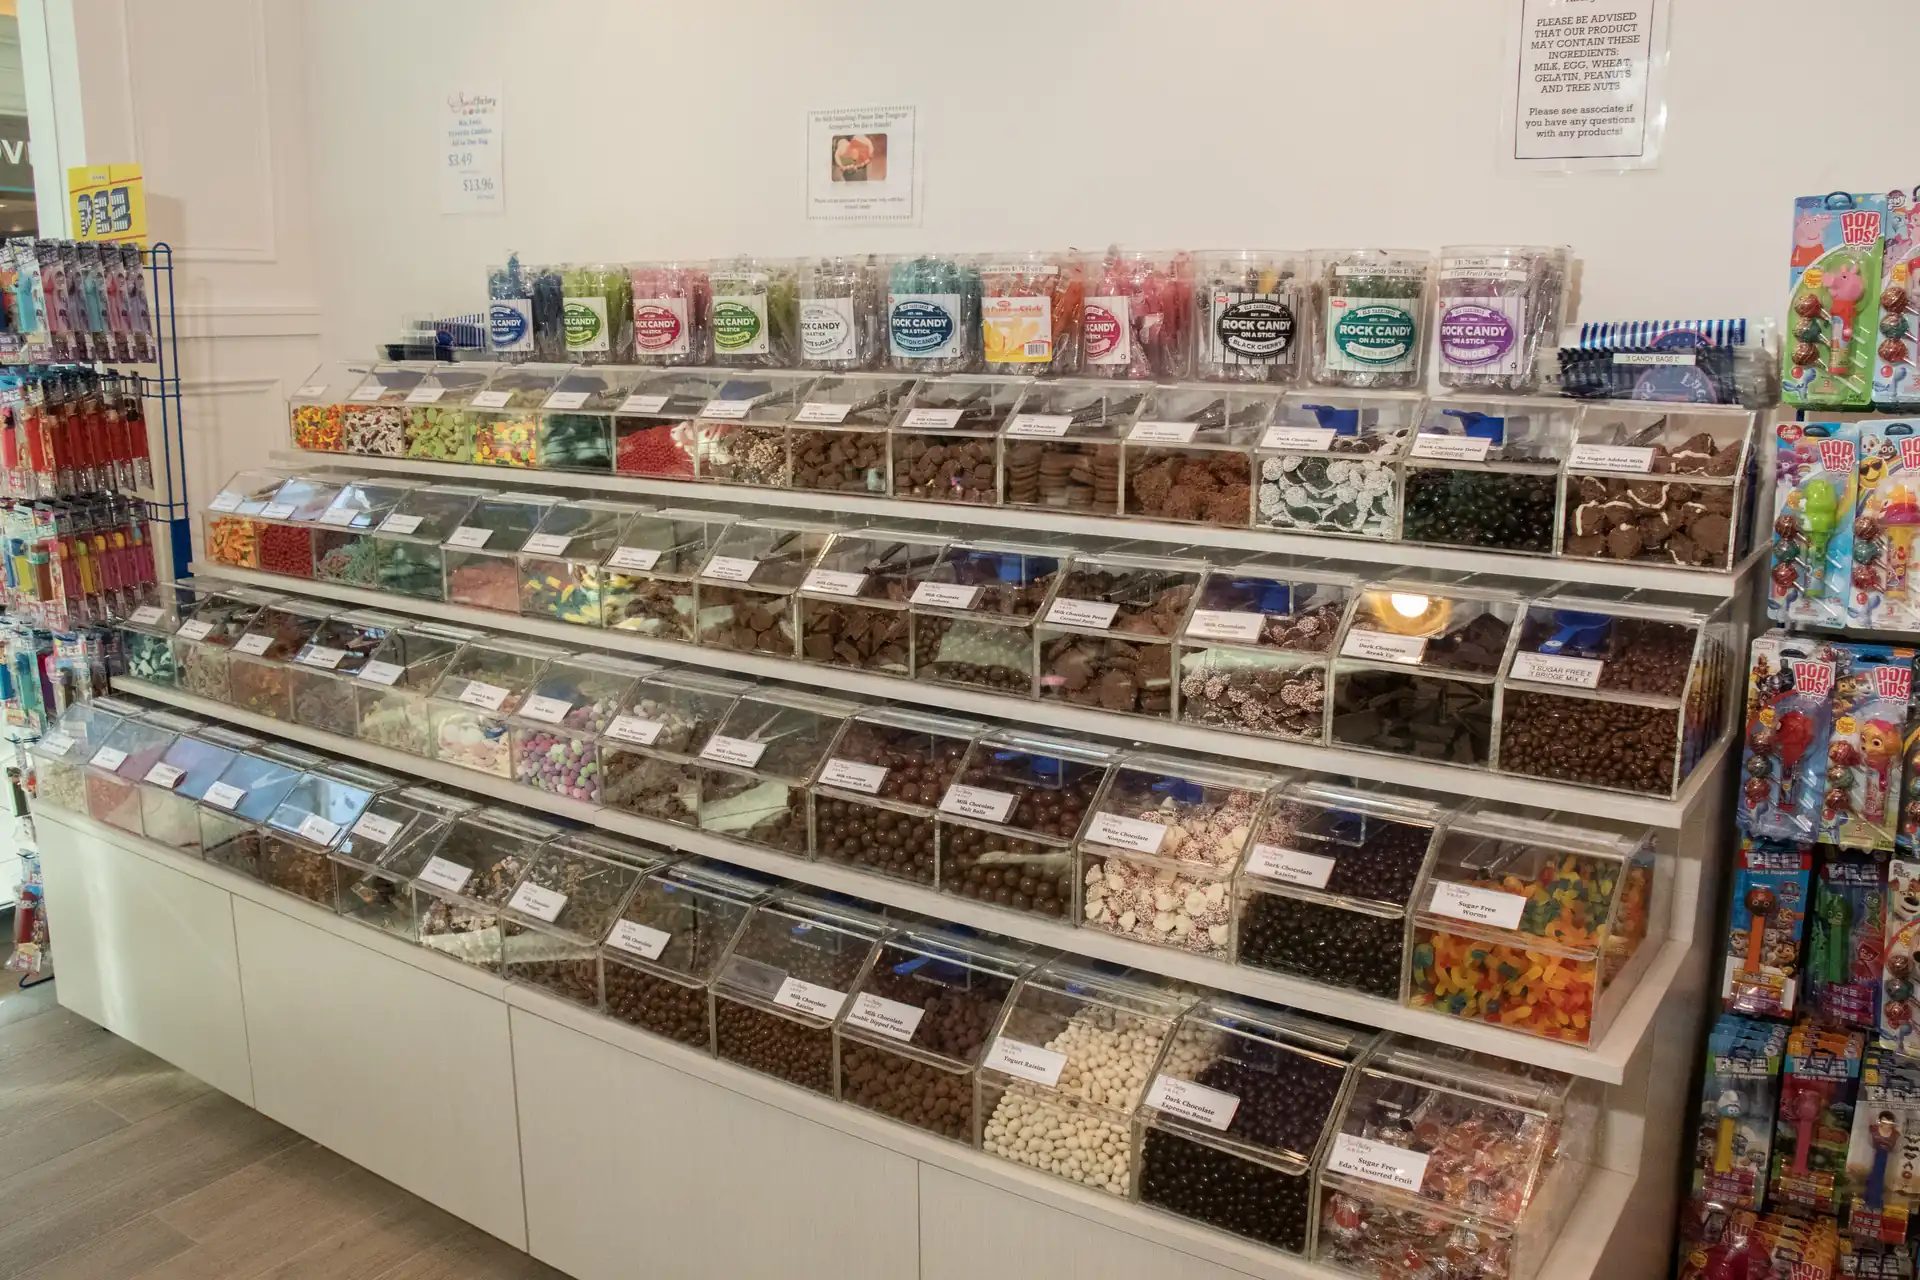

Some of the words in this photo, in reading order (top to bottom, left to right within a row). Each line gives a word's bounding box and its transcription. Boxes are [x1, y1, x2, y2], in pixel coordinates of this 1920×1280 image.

[1537, 17, 1573, 27] PLEASE
[1576, 16, 1588, 24] BE
[1590, 12, 1637, 23] ADVISED
[1535, 29, 1562, 38] THAT
[1564, 28, 1585, 36] OUR
[1588, 24, 1637, 35] PRODUCT
[1531, 40, 1554, 49] MAY
[1556, 37, 1605, 48] CONTAIN
[1608, 35, 1640, 44] THESE
[1548, 49, 1619, 59] INGREDIENTS:
[1534, 62, 1561, 71] MILK,
[1563, 61, 1589, 70] EGG,
[1592, 58, 1633, 68] WHEAT,
[1535, 73, 1581, 83] GELATIN,
[1584, 70, 1631, 80] PEANUTS
[1541, 84, 1563, 93] AND
[1566, 83, 1591, 91] TREE
[1593, 82, 1621, 91] NUTS
[1529, 107, 1559, 116] Please
[1580, 105, 1624, 113] associate
[1626, 104, 1633, 112] if
[1526, 119, 1542, 128] you
[1544, 118, 1567, 126] have
[1570, 118, 1587, 128] any
[1589, 116, 1636, 126] questions
[1537, 129, 1555, 138] with
[1558, 129, 1576, 139] any
[1578, 127, 1623, 138] products!
[448, 153, 472, 167] $3.49
[463, 178, 494, 192] $13.96
[78, 187, 132, 237] PEZ
[893, 318, 911, 327] ROCK
[913, 319, 947, 327] CANDY
[1090, 323, 1115, 331] CANDY
[1223, 320, 1255, 329] ROCK
[1257, 321, 1291, 330] CANDY
[1340, 325, 1373, 335] ROCK
[1376, 327, 1411, 336] CANDY
[1442, 326, 1464, 335] ROCK
[1465, 326, 1507, 336] CANDY
[1233, 340, 1255, 349] BLACK
[1257, 341, 1281, 349] CHERRY
[1066, 611, 1091, 619] Chocolate
[1536, 665, 1563, 674] SUGAR
[1566, 668, 1586, 676] FREE
[968, 801, 995, 810] Chocolate
[1102, 827, 1119, 836] White
[1120, 830, 1149, 842] Chocolate
[1264, 861, 1280, 869] Dark
[1281, 864, 1313, 876] Chocolate
[1458, 901, 1479, 909] Sugar
[1463, 909, 1487, 918] Worms
[790, 993, 801, 1001] Milk
[802, 997, 827, 1008] Chocolate
[864, 1009, 877, 1017] Milk
[877, 1012, 903, 1025] Chocolate
[850, 1013, 870, 1024] Double
[870, 1018, 890, 1030] Dipped
[890, 1025, 911, 1035] Peanuts
[1003, 1055, 1024, 1068] Yogurt
[1024, 1061, 1046, 1072] Raisins
[1164, 1095, 1181, 1105] Dark
[1182, 1099, 1215, 1116] Chocolate
[1161, 1102, 1190, 1117] Espresso
[1191, 1110, 1212, 1123] Beans
[1358, 1157, 1379, 1168] Sugar
[1381, 1163, 1398, 1172] Free
[1338, 1161, 1358, 1171] Eda's
[1361, 1168, 1392, 1180] Assorted
[1394, 1176, 1413, 1185] Fruit
